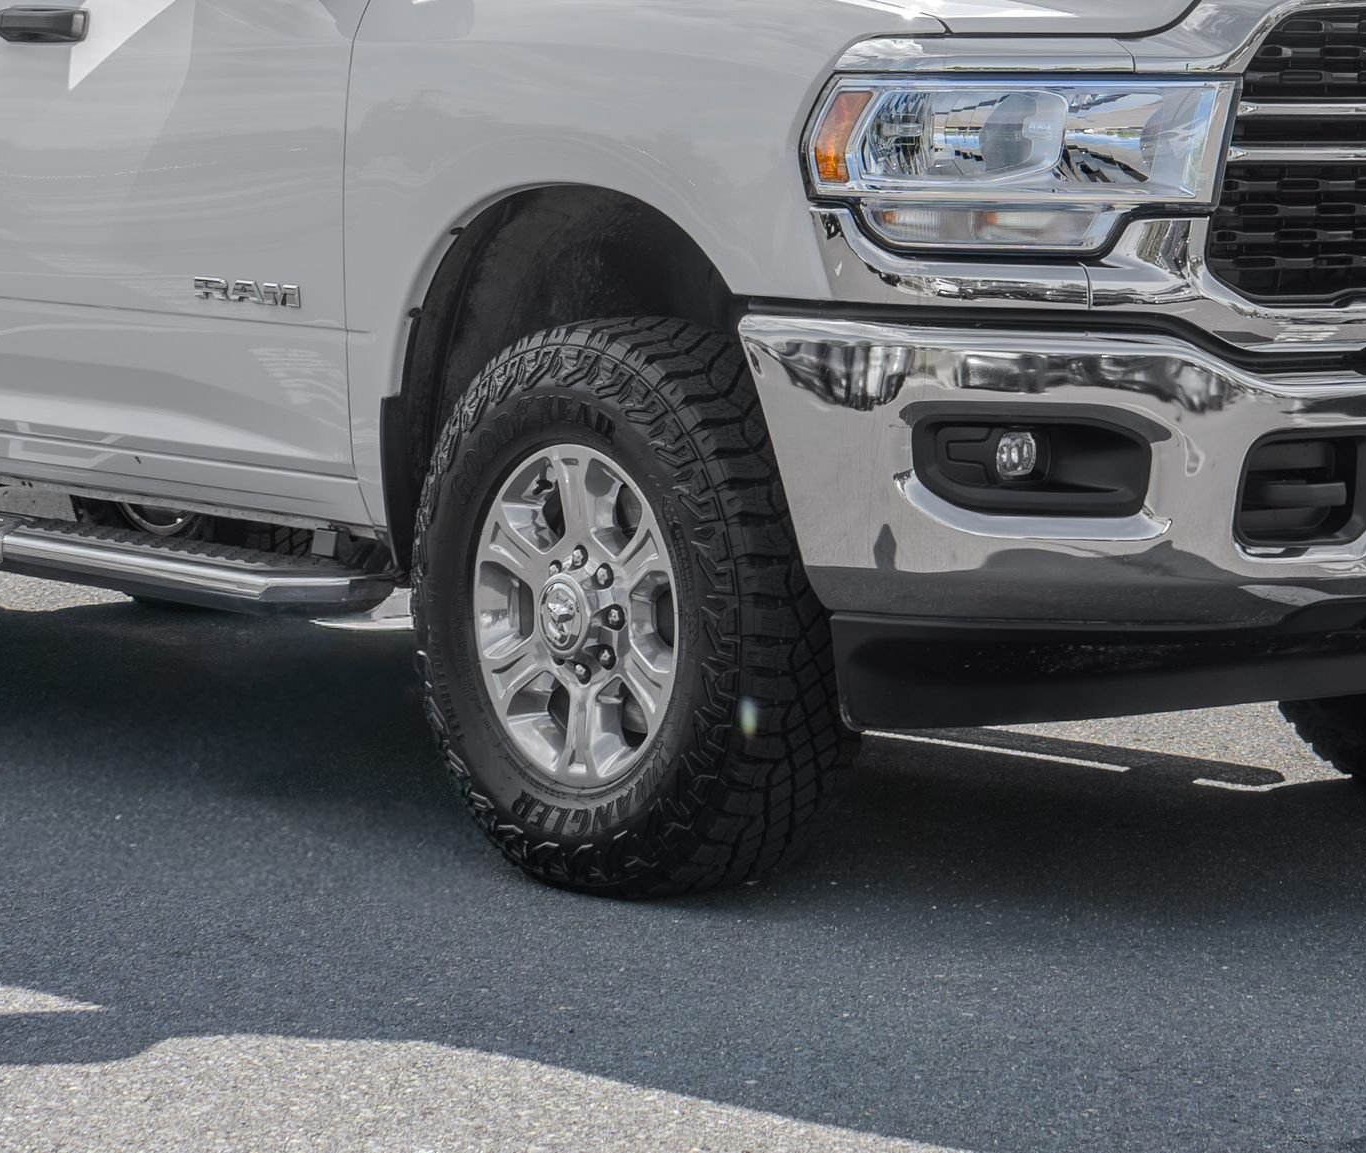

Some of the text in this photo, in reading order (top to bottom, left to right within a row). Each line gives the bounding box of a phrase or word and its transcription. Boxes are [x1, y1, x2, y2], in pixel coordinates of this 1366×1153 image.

[193, 276, 301, 308] RAM
[451, 394, 617, 504] GOODYEAR
[512, 742, 674, 837] WRANGLER
